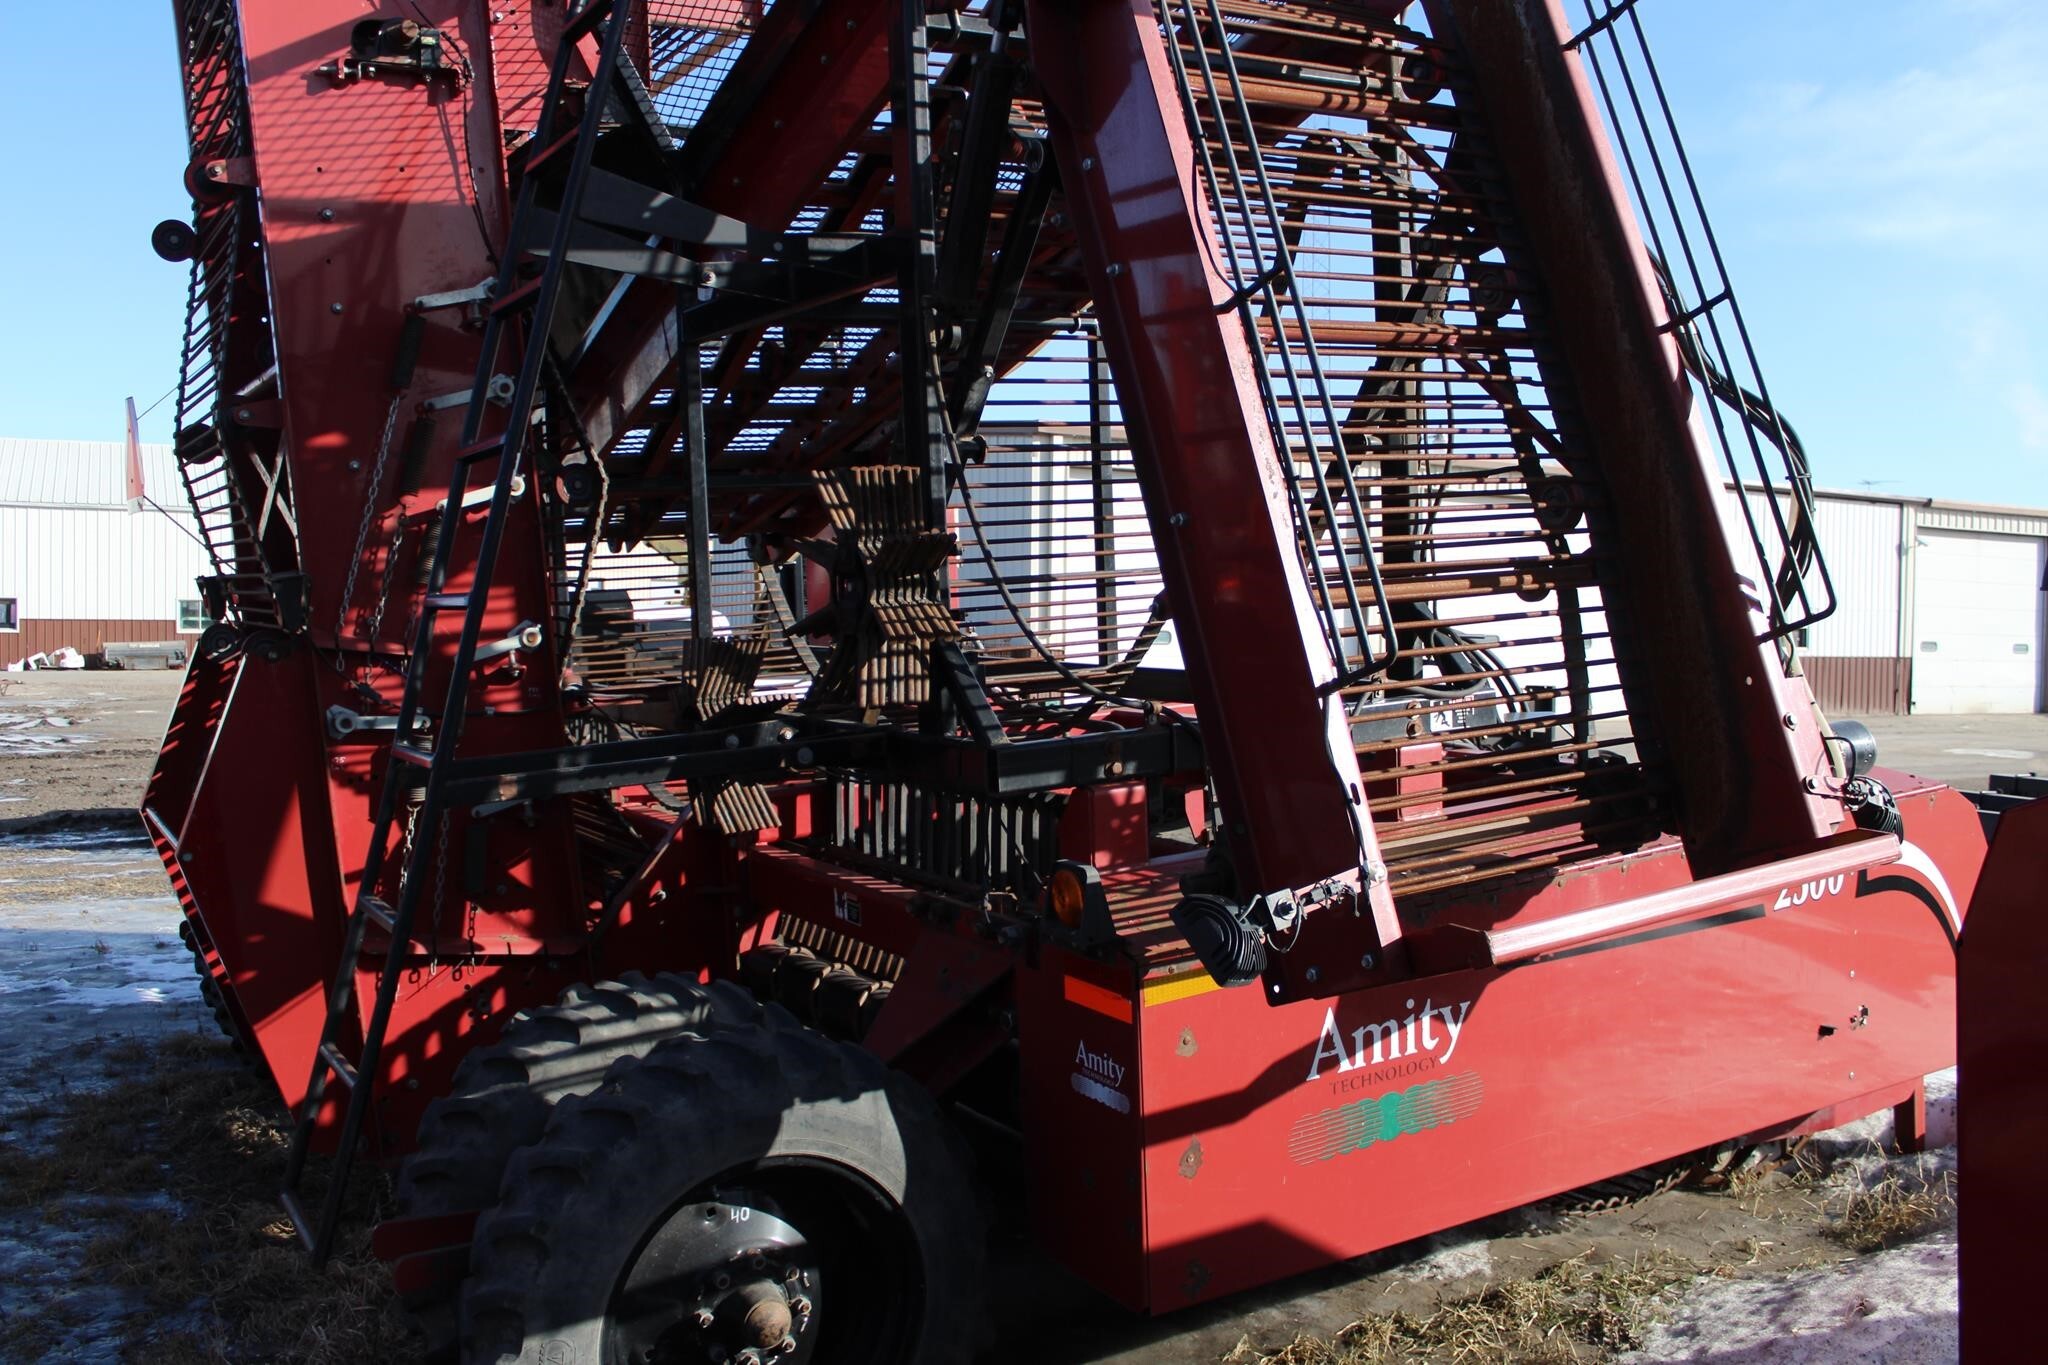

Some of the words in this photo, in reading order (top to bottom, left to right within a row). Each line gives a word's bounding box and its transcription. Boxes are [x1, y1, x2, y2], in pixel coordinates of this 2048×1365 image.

[1306, 998, 1471, 1081] Amity
[1075, 1039, 1125, 1088] Amity
[1329, 1056, 1439, 1096] TECHNOLOGY
[730, 1206, 750, 1224] 40
